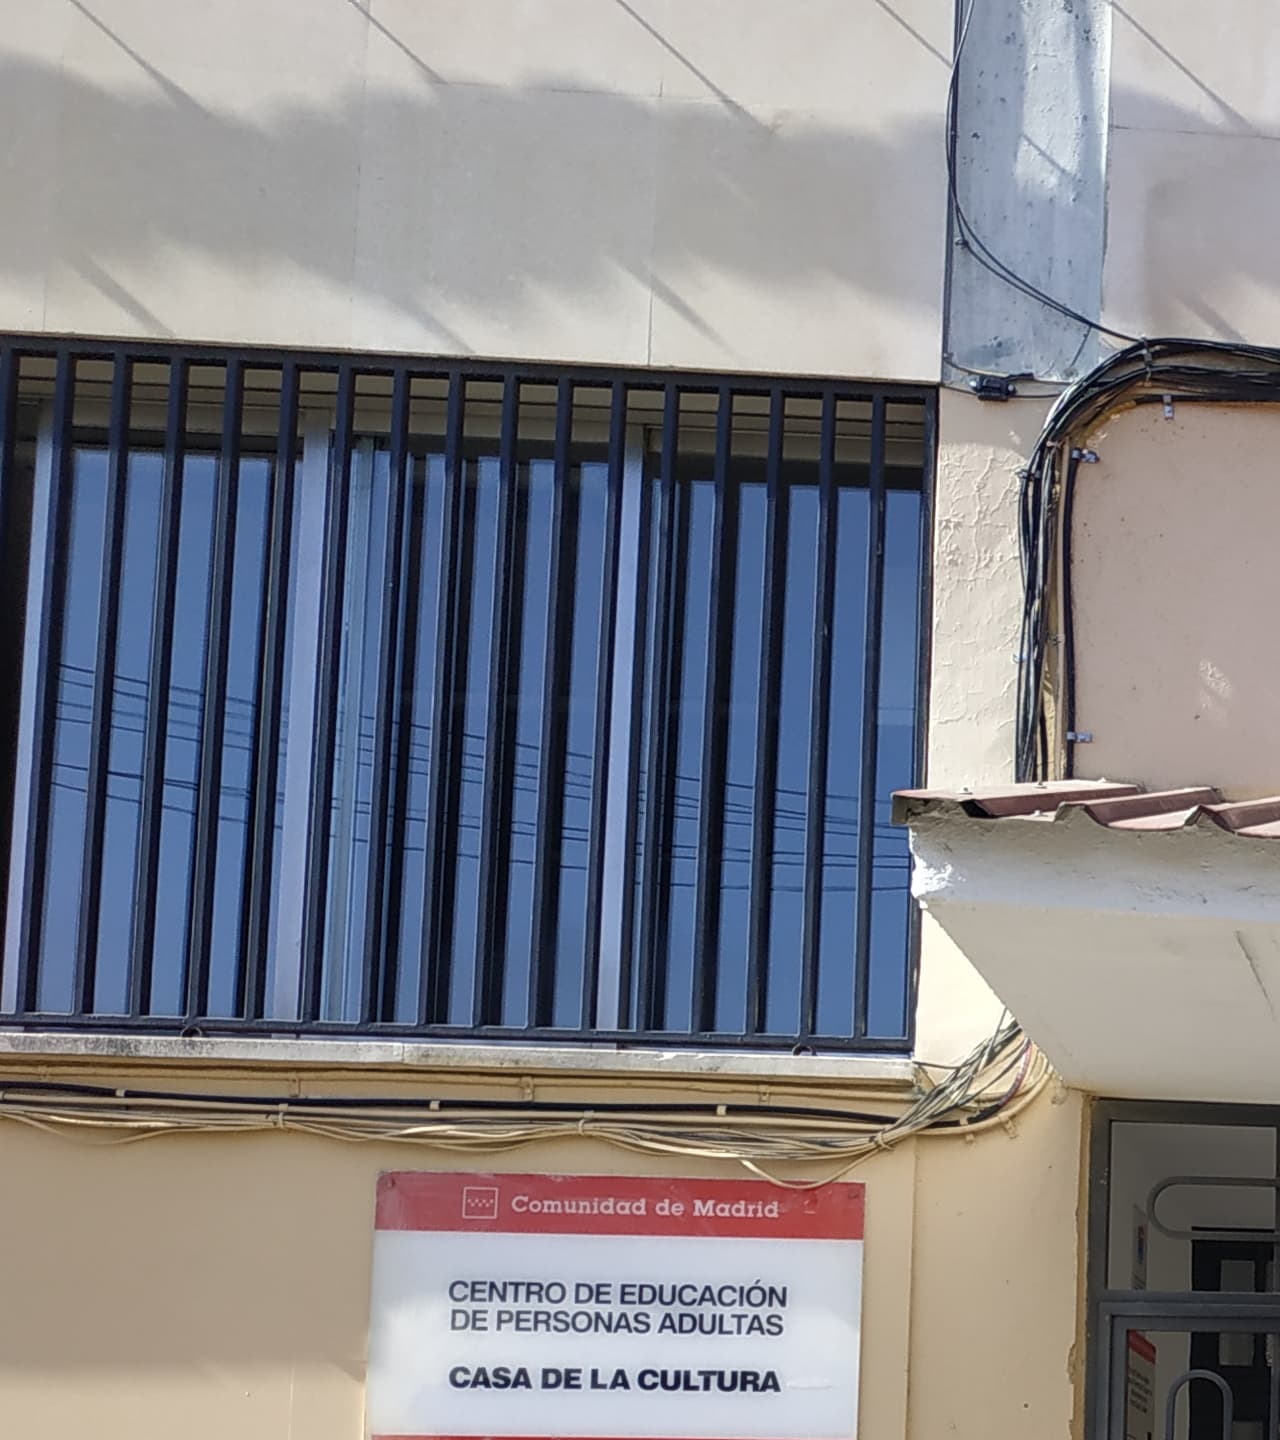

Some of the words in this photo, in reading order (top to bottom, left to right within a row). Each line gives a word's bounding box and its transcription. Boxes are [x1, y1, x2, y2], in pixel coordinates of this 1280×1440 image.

[511, 1195, 646, 1216] Comunidad
[656, 1199, 684, 1217] de
[693, 1198, 779, 1219] Madrid
[448, 1281, 566, 1304] CENTRO
[574, 1283, 610, 1305] DE
[619, 1279, 787, 1308] EDUCACIÓN
[451, 1309, 487, 1332] DE
[496, 1311, 650, 1334] PERSONAS
[658, 1313, 784, 1336] ADULTAS
[448, 1367, 532, 1389] CASA
[542, 1368, 581, 1390] DE
[591, 1369, 630, 1391] LA
[638, 1370, 780, 1393] CULTURA
